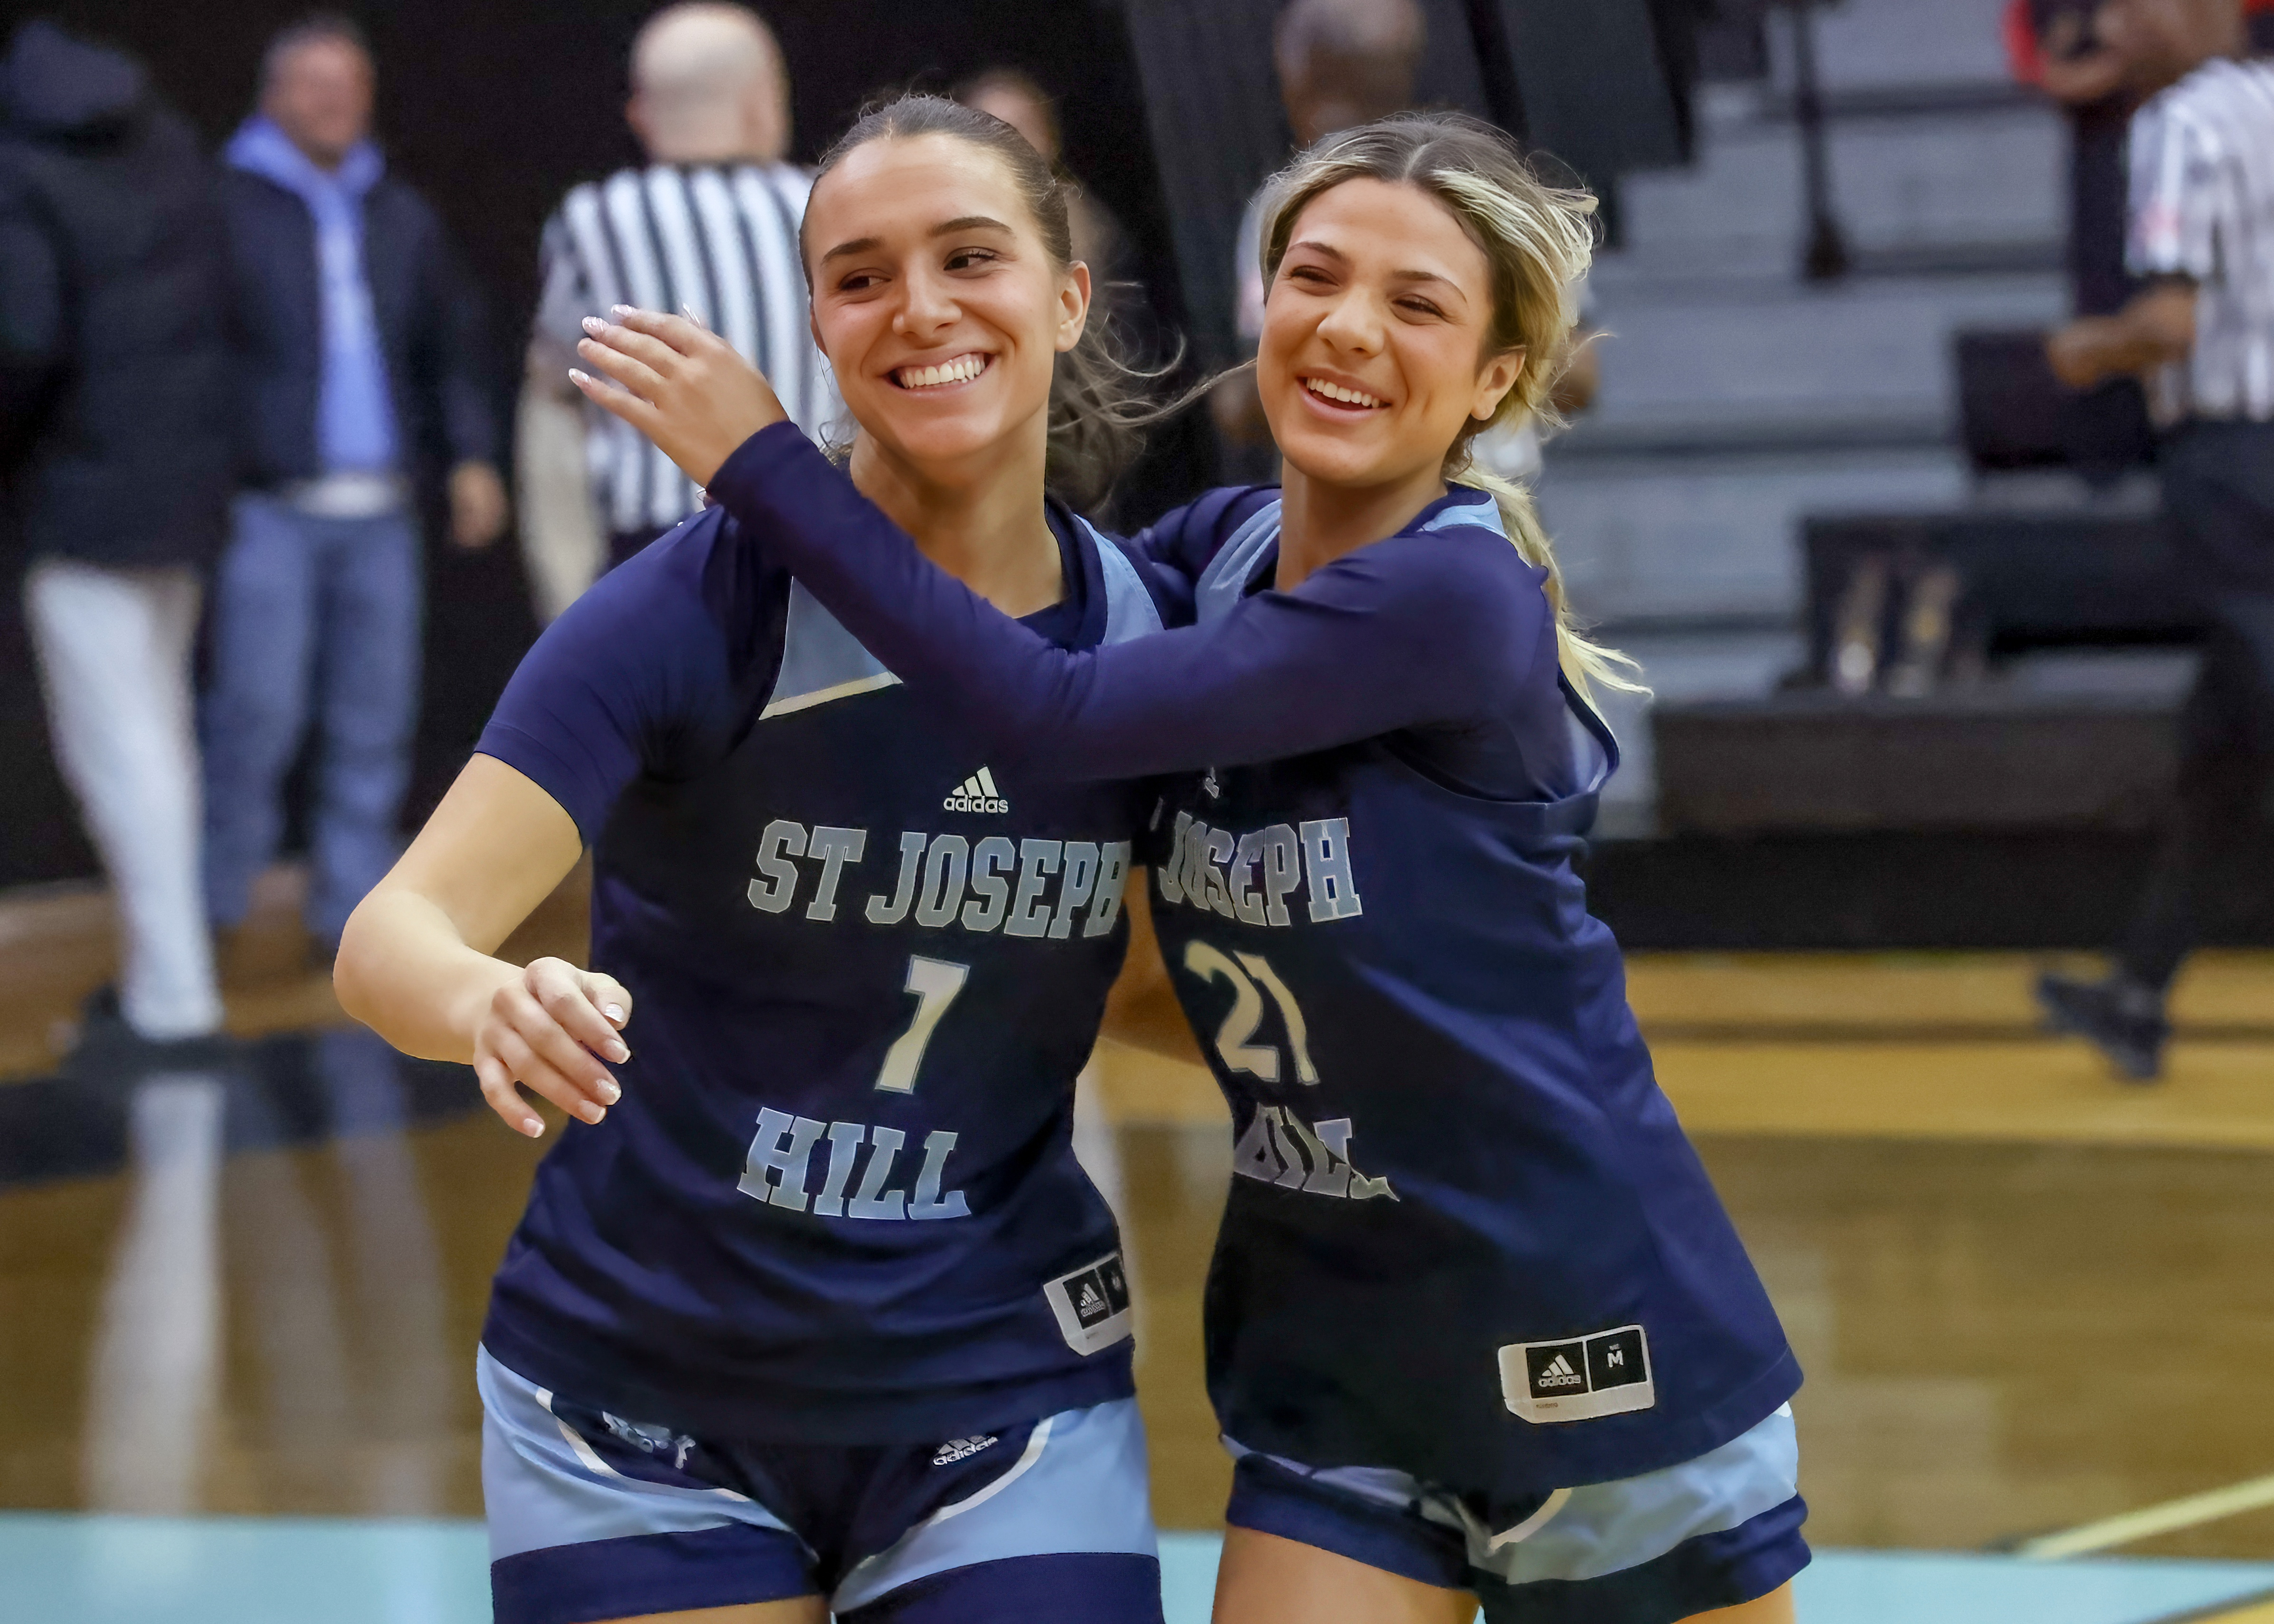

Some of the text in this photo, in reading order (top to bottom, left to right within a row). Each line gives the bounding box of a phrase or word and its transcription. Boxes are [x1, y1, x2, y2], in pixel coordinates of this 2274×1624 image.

[943, 795, 1009, 814] adidas
[747, 819, 867, 921] ST
[1158, 810, 1363, 926] JOSEPH
[873, 954, 970, 1094] 1
[1184, 939, 1321, 1086] 21
[736, 1106, 972, 1220] HILL
